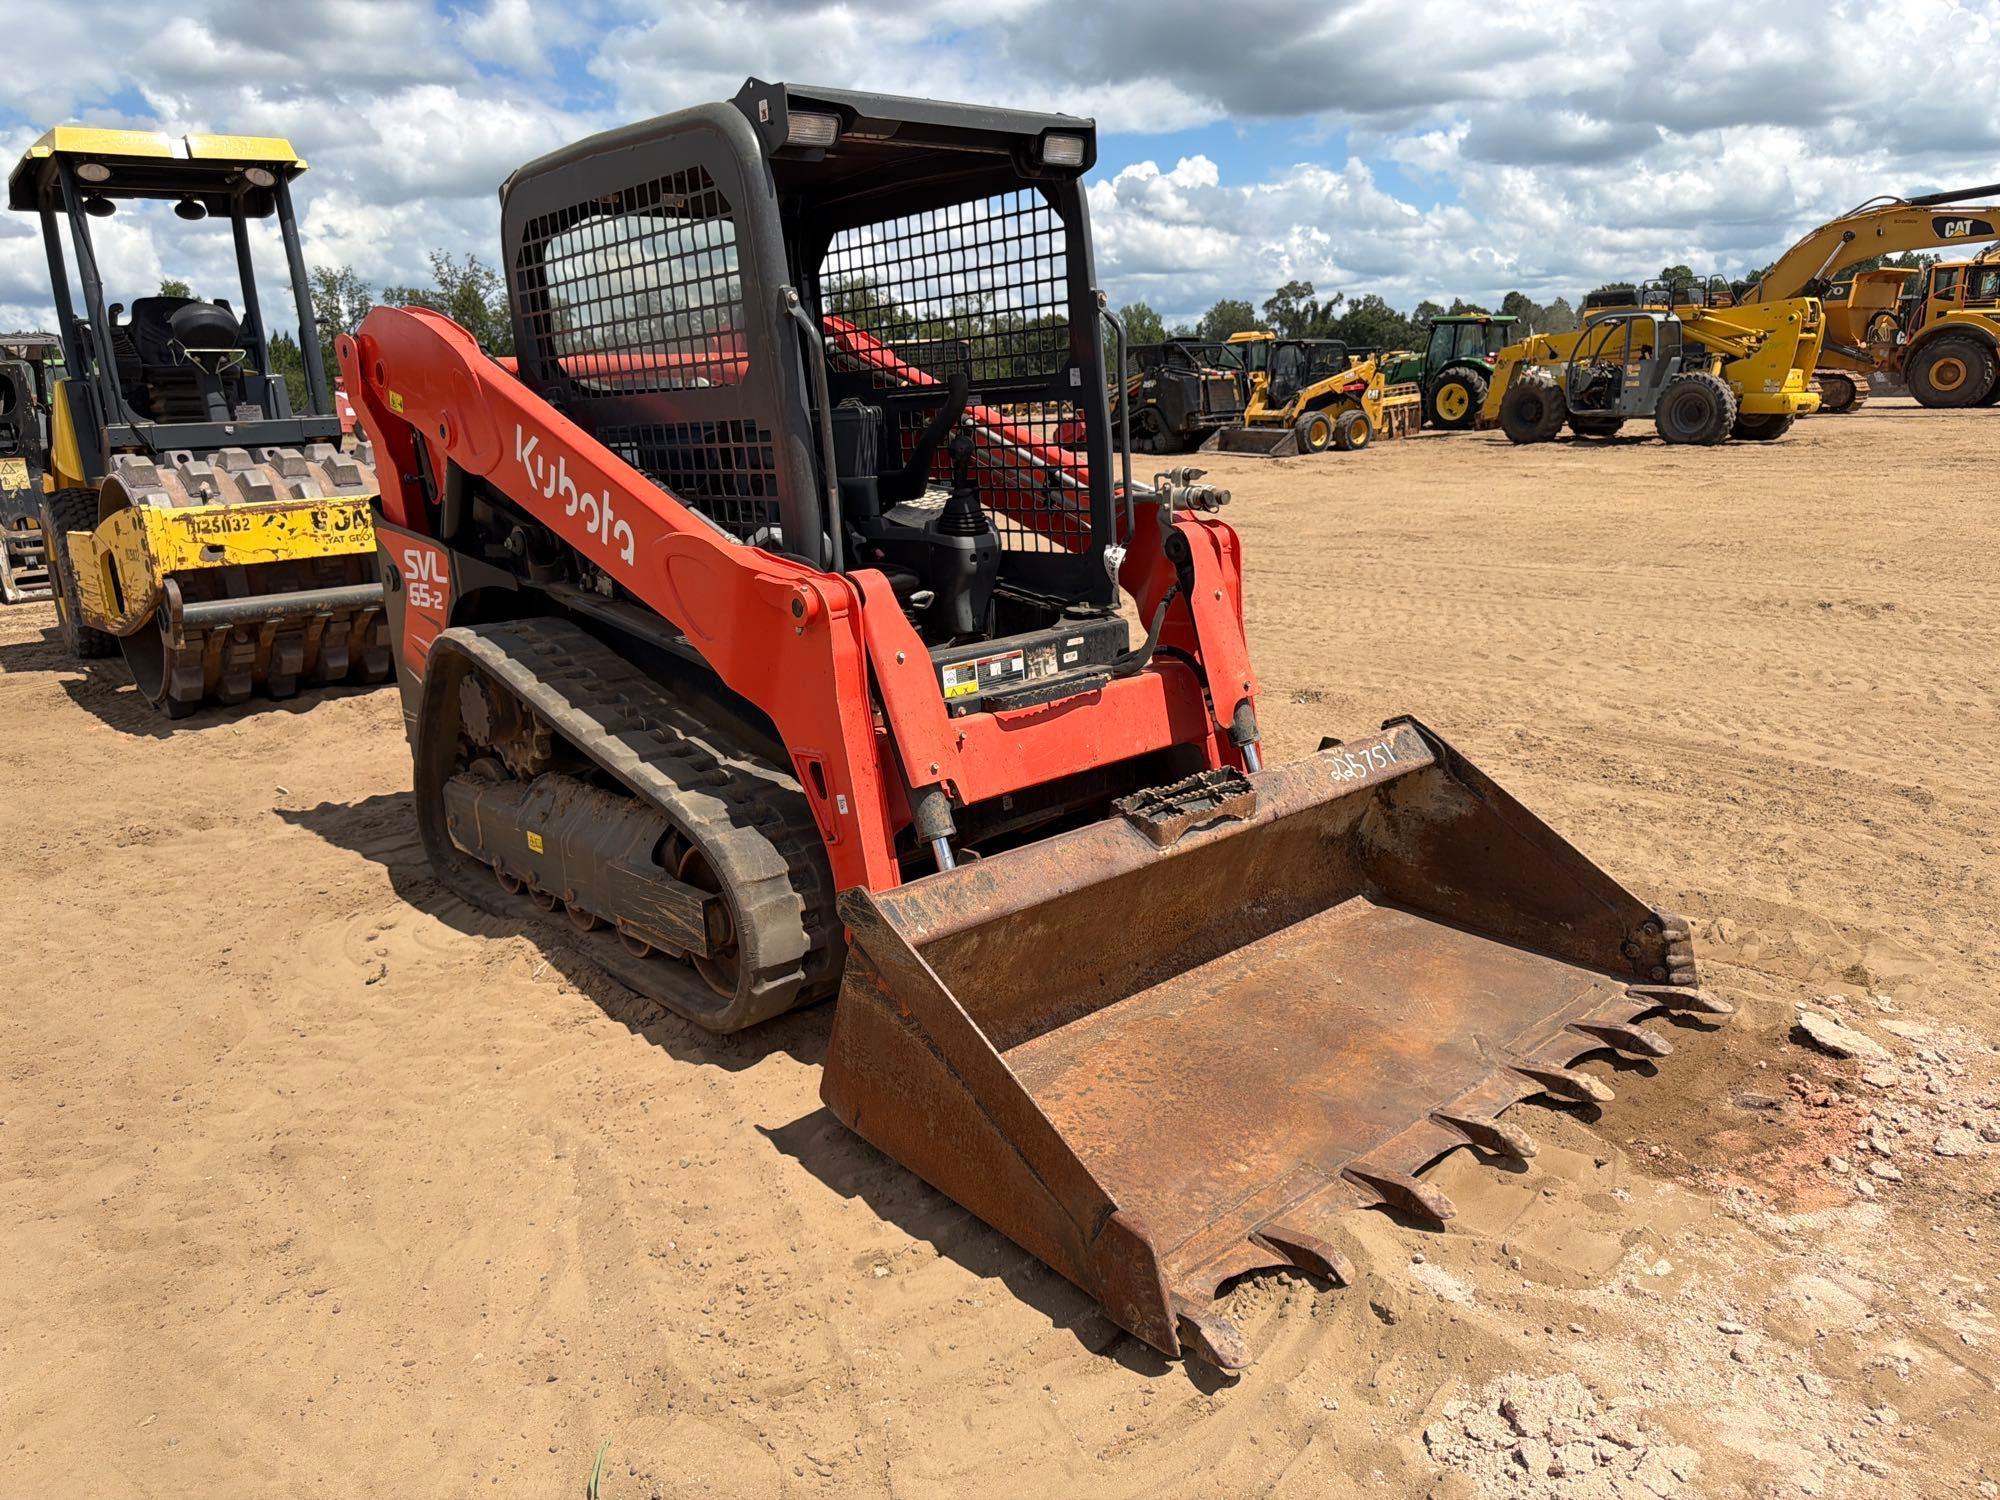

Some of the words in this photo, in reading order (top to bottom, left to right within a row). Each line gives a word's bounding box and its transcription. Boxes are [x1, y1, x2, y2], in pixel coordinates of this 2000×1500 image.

[1944, 219, 1974, 238] CAT
[516, 423, 635, 567] Kubota
[403, 549, 448, 584] SVL
[409, 583, 444, 610] 65-2
[1324, 742, 1397, 781] 225751
